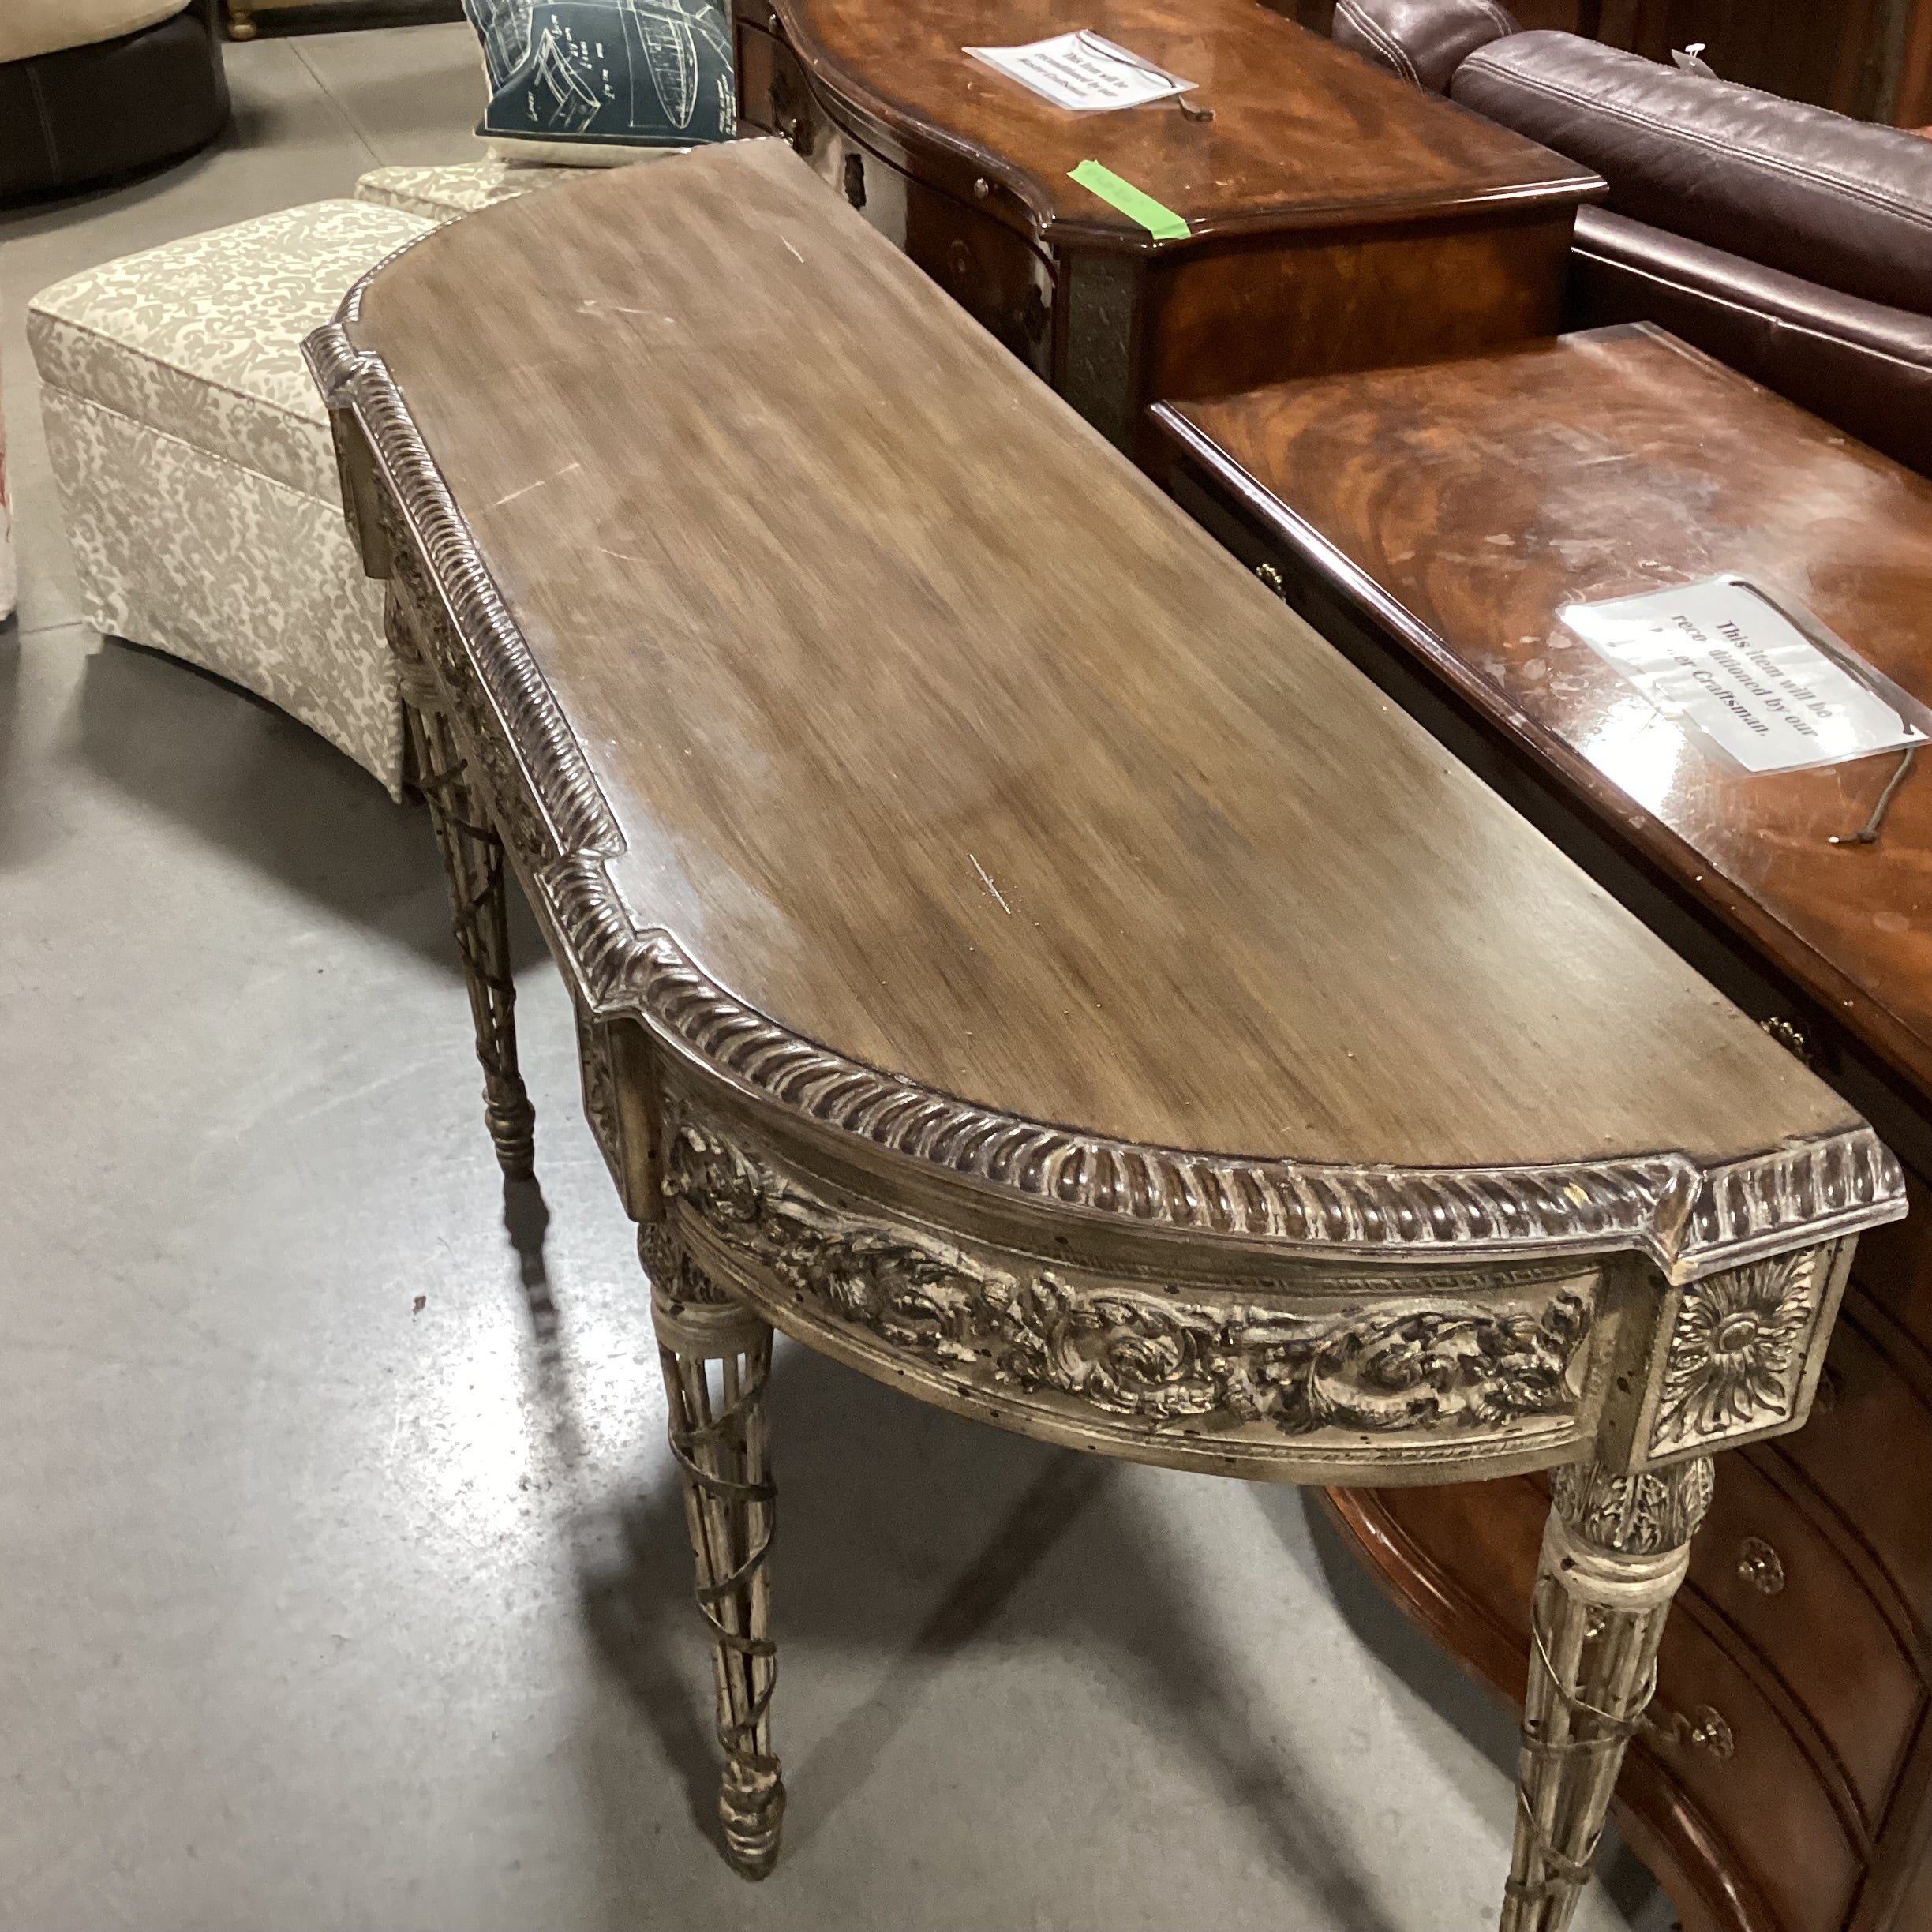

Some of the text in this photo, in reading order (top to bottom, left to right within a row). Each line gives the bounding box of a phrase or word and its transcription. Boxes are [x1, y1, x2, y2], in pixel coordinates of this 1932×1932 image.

[1671, 616, 1773, 695] recoditioned
[1764, 698, 1790, 712] by
[1785, 716, 1818, 736] our
[1692, 671, 1769, 736] Craftsman.
[1716, 620, 1750, 648] This
[1745, 650, 1784, 677] item
[1780, 680, 1816, 700] will
[1806, 702, 1833, 717] be
